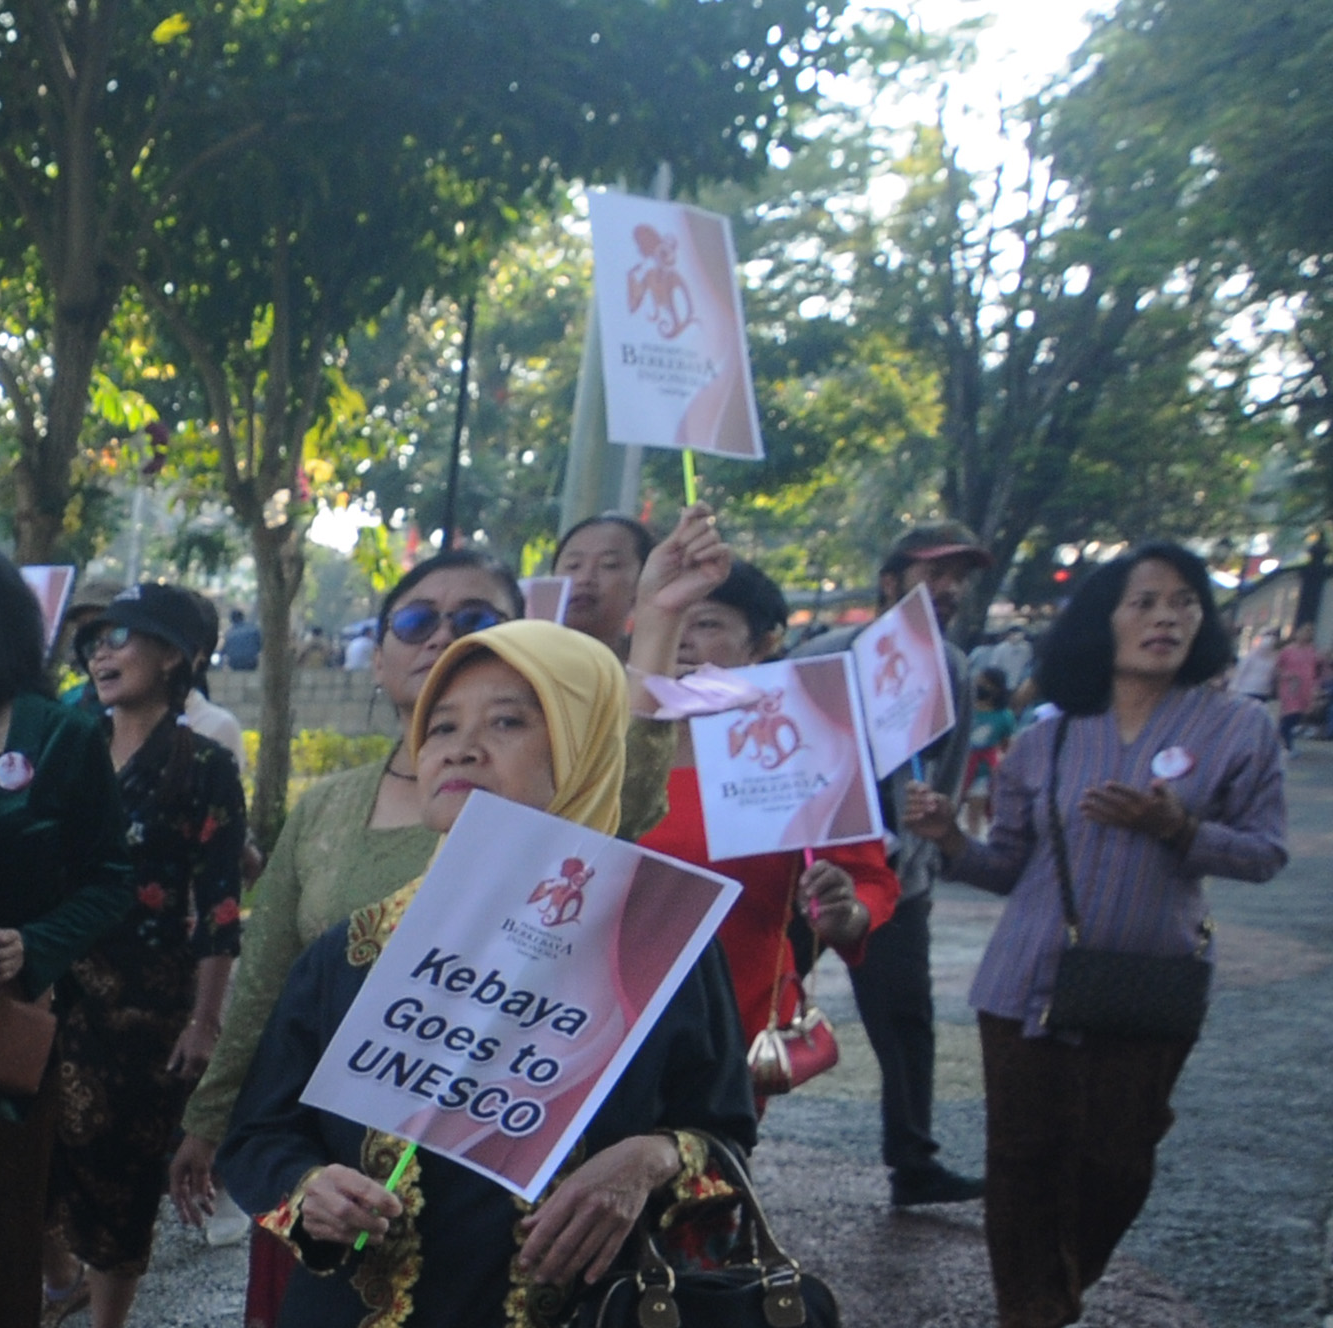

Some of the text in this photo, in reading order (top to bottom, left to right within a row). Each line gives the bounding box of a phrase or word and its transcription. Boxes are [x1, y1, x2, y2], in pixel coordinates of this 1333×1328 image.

[410, 948, 587, 1036] Kebaya
[384, 998, 559, 1082] Goes to
[347, 1039, 541, 1133] UNESCO
